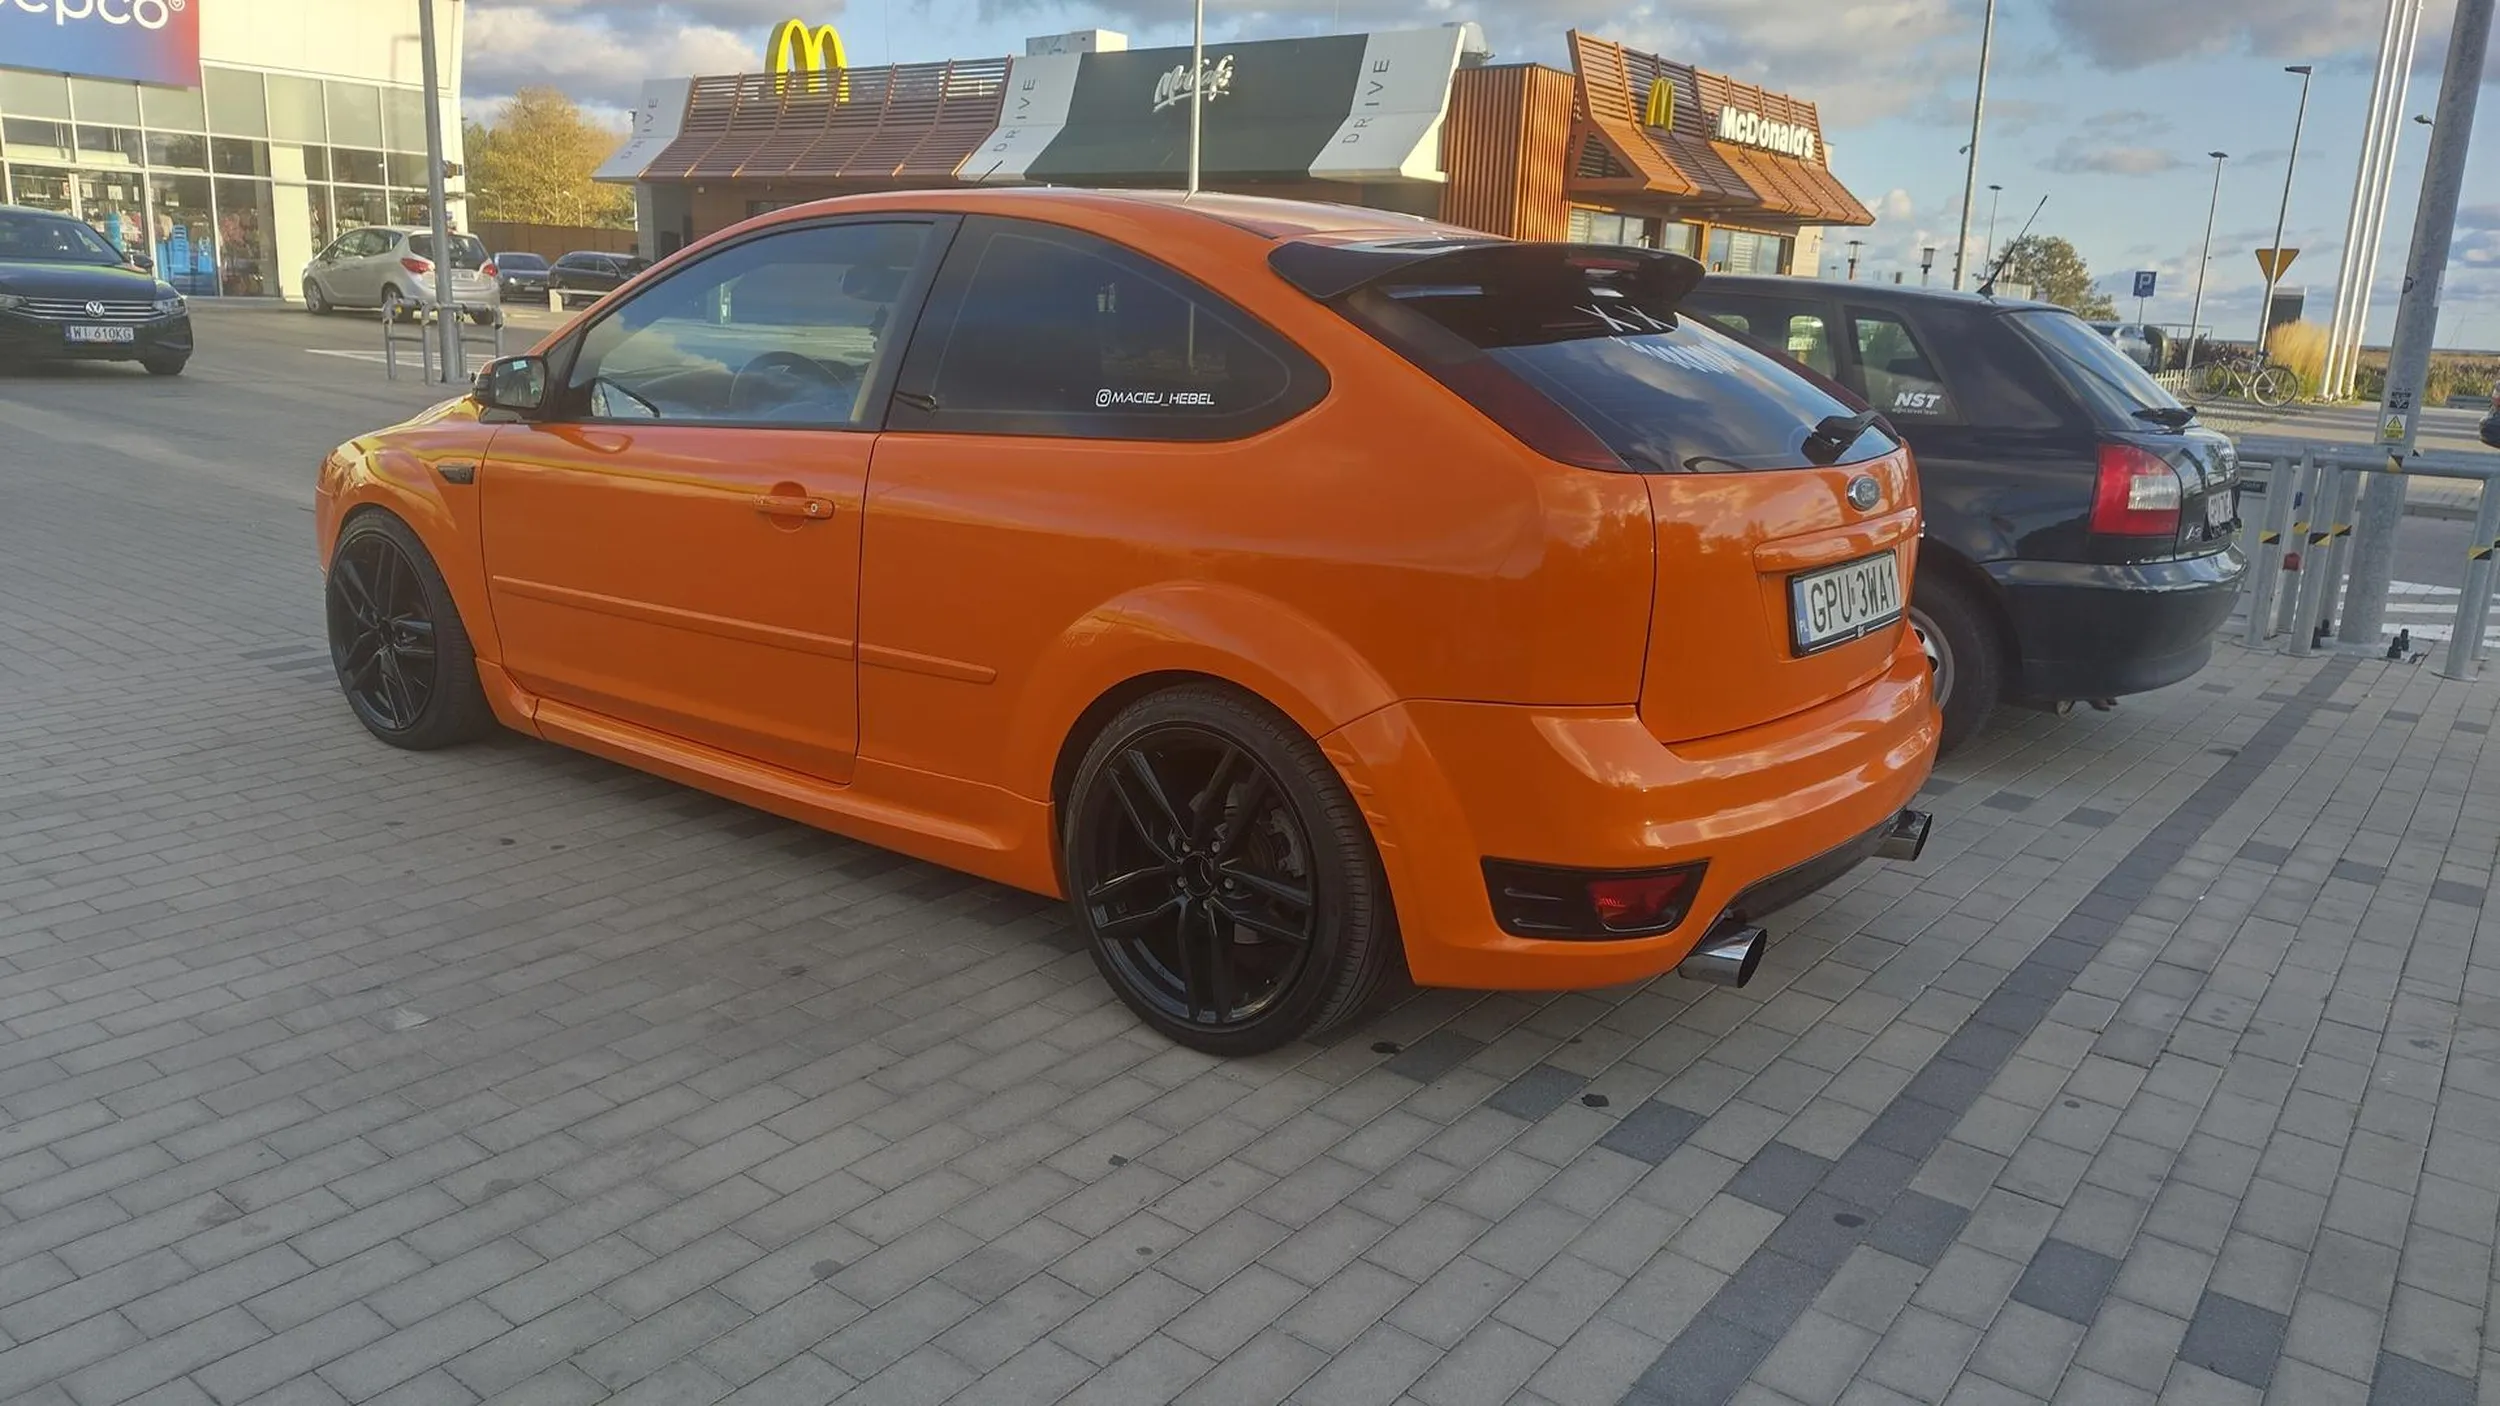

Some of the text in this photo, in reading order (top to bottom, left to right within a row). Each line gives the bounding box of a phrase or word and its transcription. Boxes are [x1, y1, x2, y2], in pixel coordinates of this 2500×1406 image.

[993, 79, 1036, 152] DRIVE
[1342, 60, 1390, 143] DRIVE
[1719, 106, 1815, 159] McDonald's
[2139, 273, 2152, 289] P
[1894, 392, 1942, 408] NST
[1810, 561, 1897, 633] GPU 3WA1
